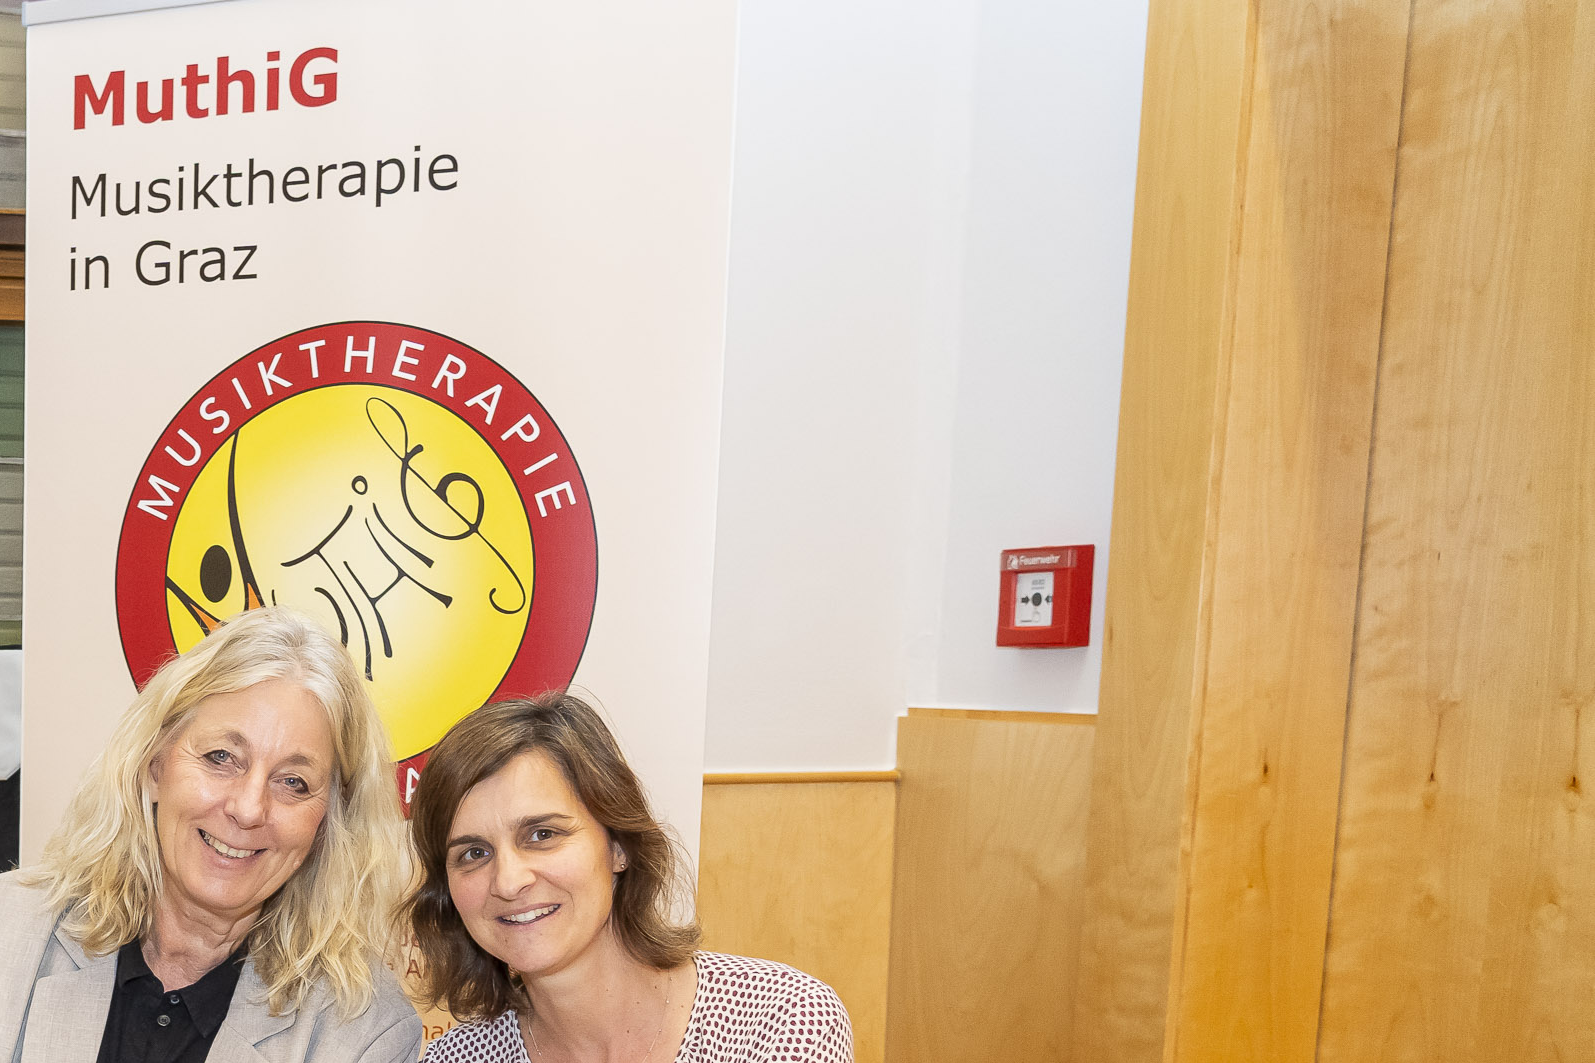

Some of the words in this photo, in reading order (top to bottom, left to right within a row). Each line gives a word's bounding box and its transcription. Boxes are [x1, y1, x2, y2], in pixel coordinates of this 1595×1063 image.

[72, 47, 339, 131] MuthiG
[70, 145, 459, 220] Musiktherapie
[68, 245, 110, 291] in
[134, 240, 258, 285] Graz
[137, 335, 577, 521] MUSIKTHERAPIE
[1018, 554, 1061, 566] Feuerwehr
